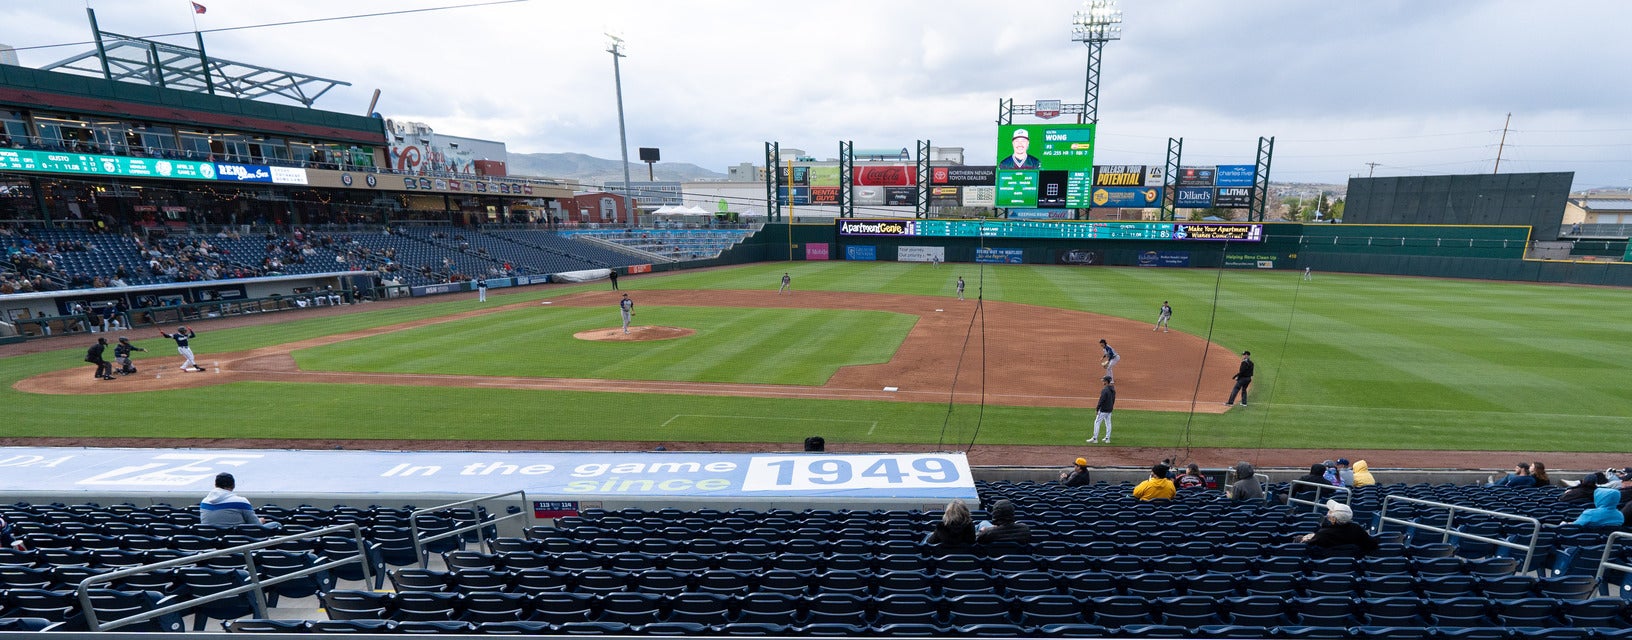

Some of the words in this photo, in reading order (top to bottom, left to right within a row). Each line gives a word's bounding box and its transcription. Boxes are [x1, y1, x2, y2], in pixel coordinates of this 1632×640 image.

[1096, 173, 1141, 186] POTENTIAL
[1178, 191, 1211, 200] Dillard's
[1226, 188, 1249, 196] LITHIA
[842, 222, 905, 234] ApartmentGenie
[380, 462, 442, 477] In
[460, 461, 555, 476] the
[570, 461, 738, 478] game
[767, 458, 961, 486] 1949
[563, 476, 731, 492] since
